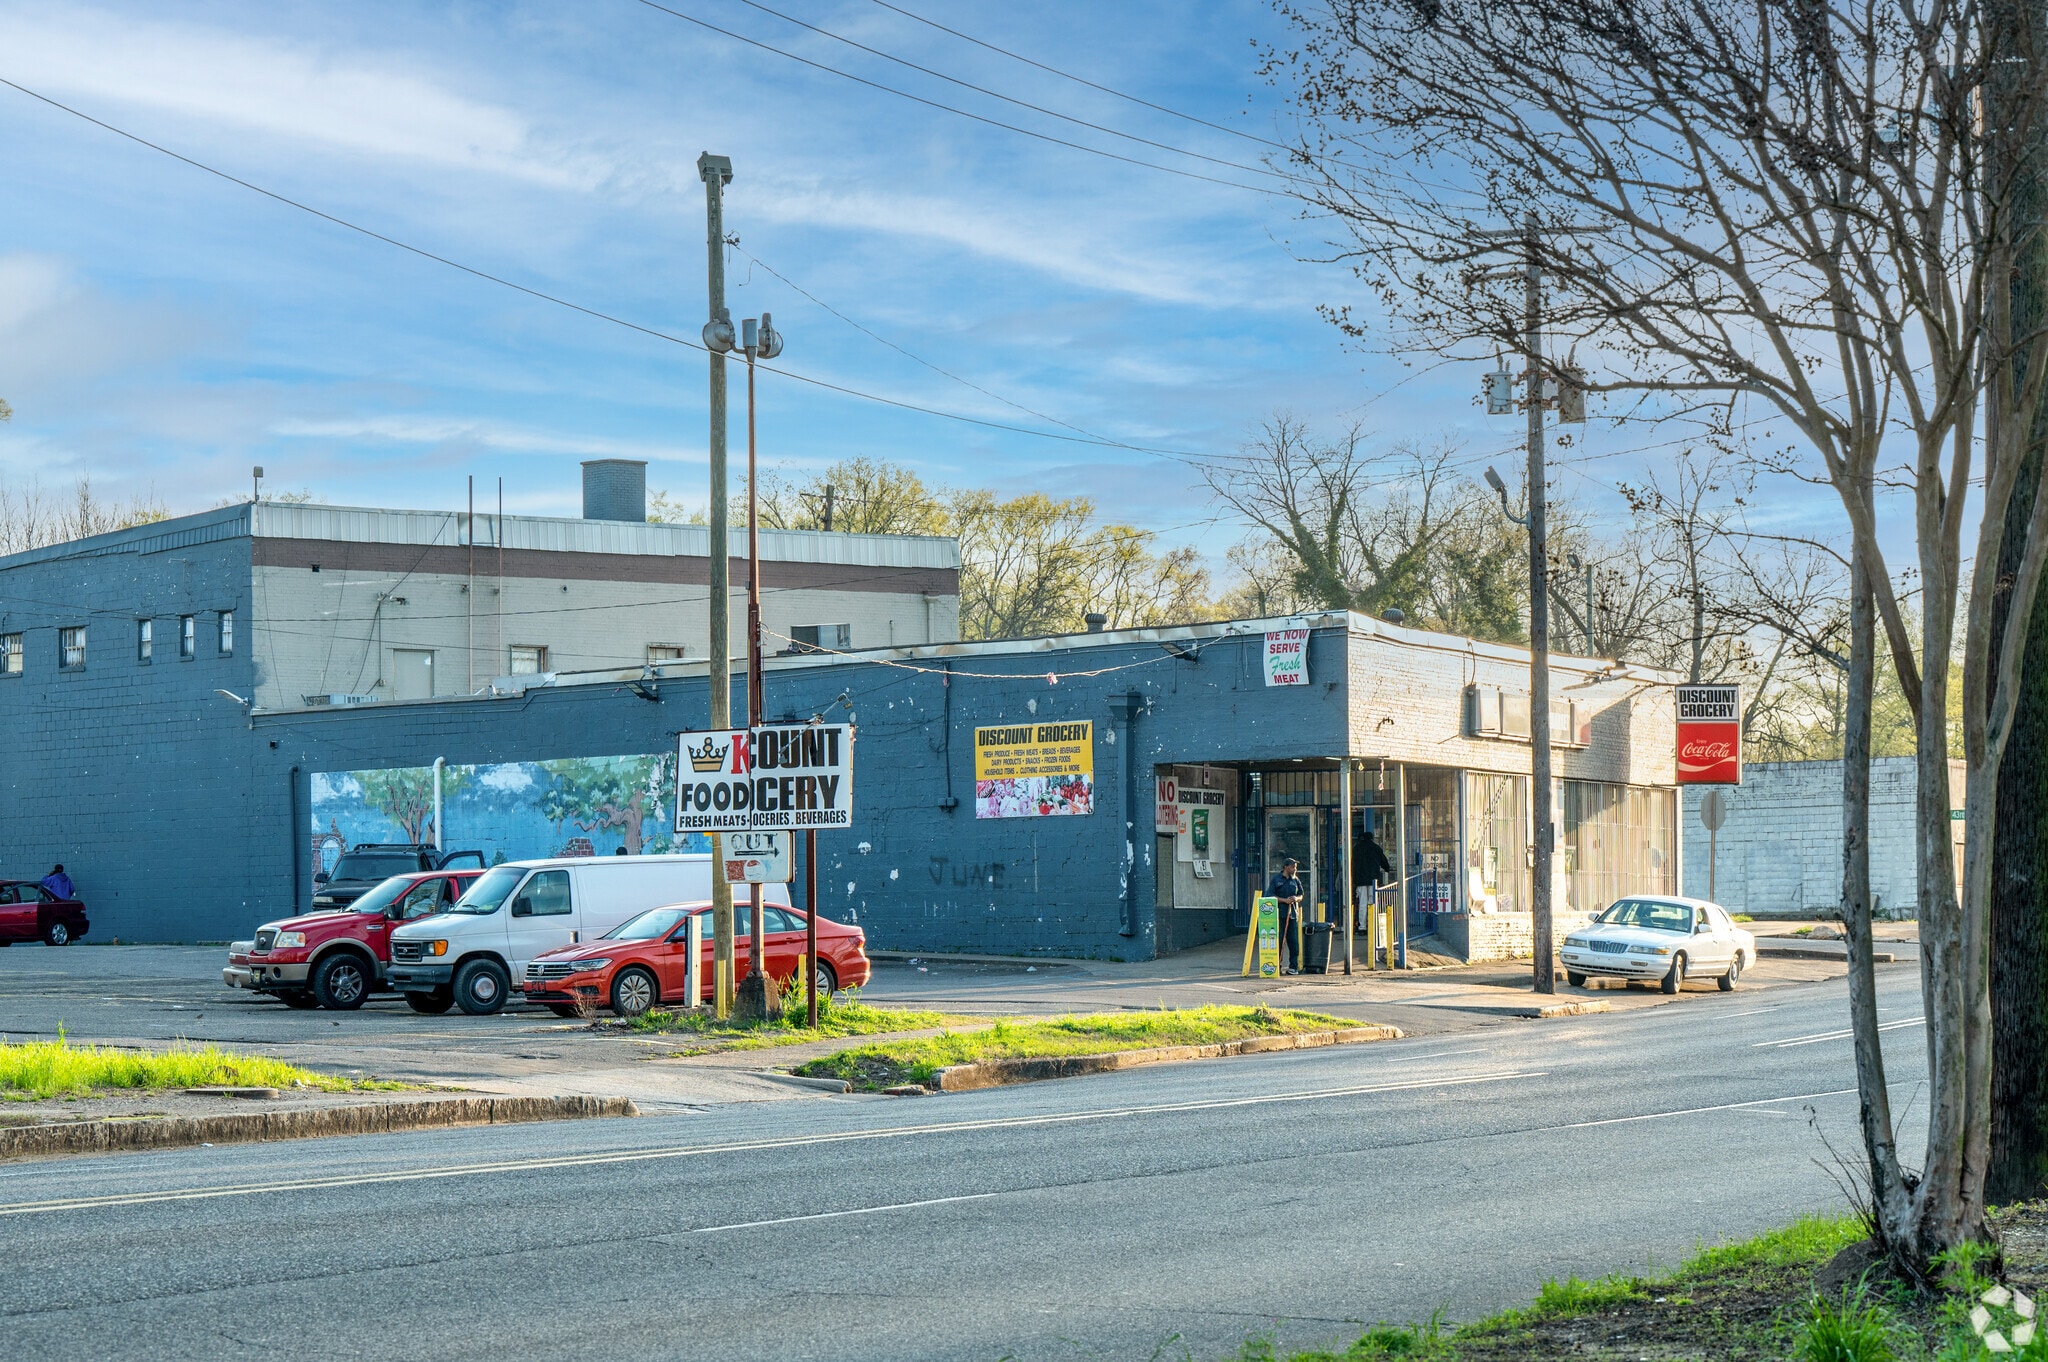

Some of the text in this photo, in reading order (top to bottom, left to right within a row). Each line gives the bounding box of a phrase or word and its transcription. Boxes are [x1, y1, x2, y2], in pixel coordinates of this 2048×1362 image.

[1266, 629, 1308, 641] WE NOW
[1269, 643, 1300, 655] SERVE
[1269, 652, 1301, 676] Fresh
[1274, 673, 1299, 684] MEAT
[1679, 689, 1736, 703] DISCOUNT
[1680, 704, 1734, 717] GROCERY
[978, 723, 1088, 746] DISCOUNT GROCERY
[1682, 742, 1732, 758] Coca-Cola
[681, 781, 749, 812] FOOD
[750, 774, 840, 811] CERY
[1158, 781, 1175, 802] NO
[1178, 790, 1225, 806] DISCOUNT GROCERY
[679, 815, 711, 828] FRESH
[795, 810, 847, 825] BEVERAGES
[731, 832, 778, 850] OUT
[1417, 898, 1449, 912] EBT
